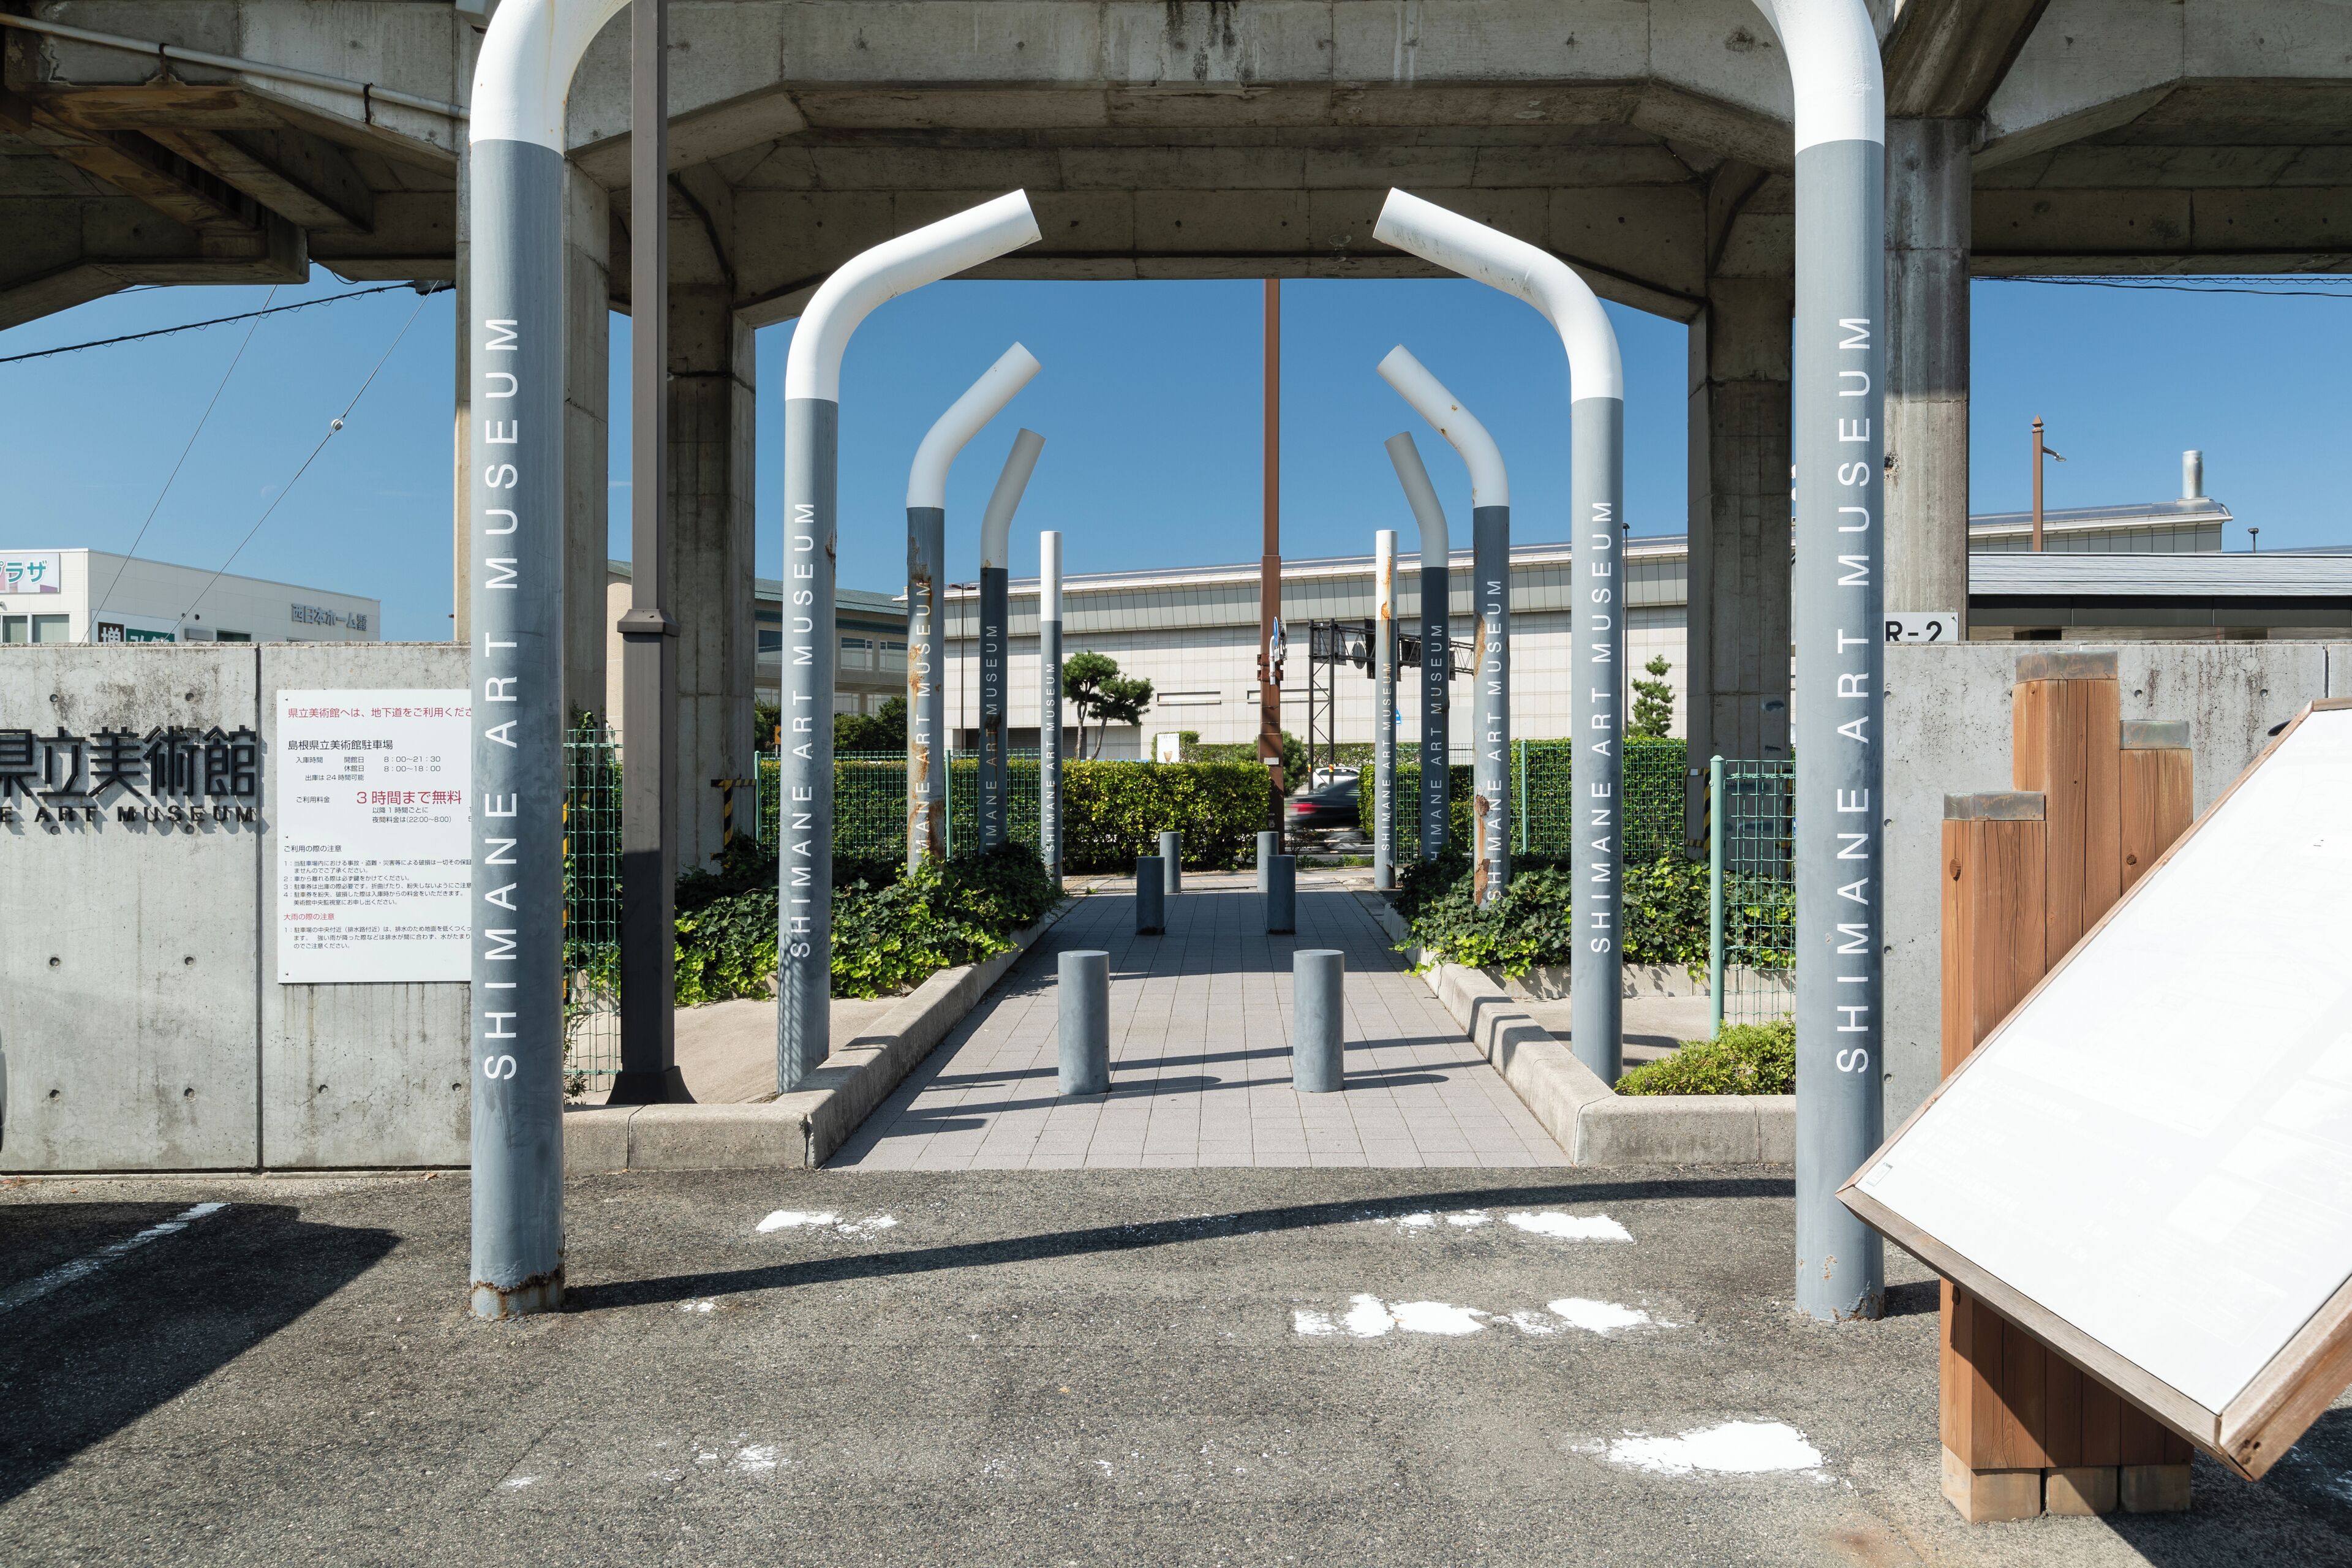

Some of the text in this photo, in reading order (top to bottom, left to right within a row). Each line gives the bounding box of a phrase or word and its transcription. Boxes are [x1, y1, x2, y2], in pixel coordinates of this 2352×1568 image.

[484, 318, 519, 1080] SHIMANE ART MUSEUM
[916, 582, 932, 697] MUSEUM
[1836, 318, 1871, 1073] SHIMANE ART MUSEUM
[1885, 621, 1942, 641] R-2
[0, 725, 257, 797] 県立美術館
[34, 805, 97, 823] ART
[117, 805, 256, 823] MUSEUM
[288, 739, 393, 750] 島根県立美術館駐車場
[790, 503, 815, 958] SHIMANE ART MUSEUM
[916, 714, 930, 764] ART
[986, 625, 998, 846] IMANE ART MUSEUM
[1046, 663, 1055, 852] SHIMANE ART MUSEUM
[1382, 663, 1392, 851] SHIMANE ART MUSEUM
[1430, 625, 1442, 861] HIMANE ART MUSEUM
[1487, 581, 1502, 902] SHIMANE ART MUSEUM
[1591, 502, 1612, 953] SHIMANE ART MUSEUM
